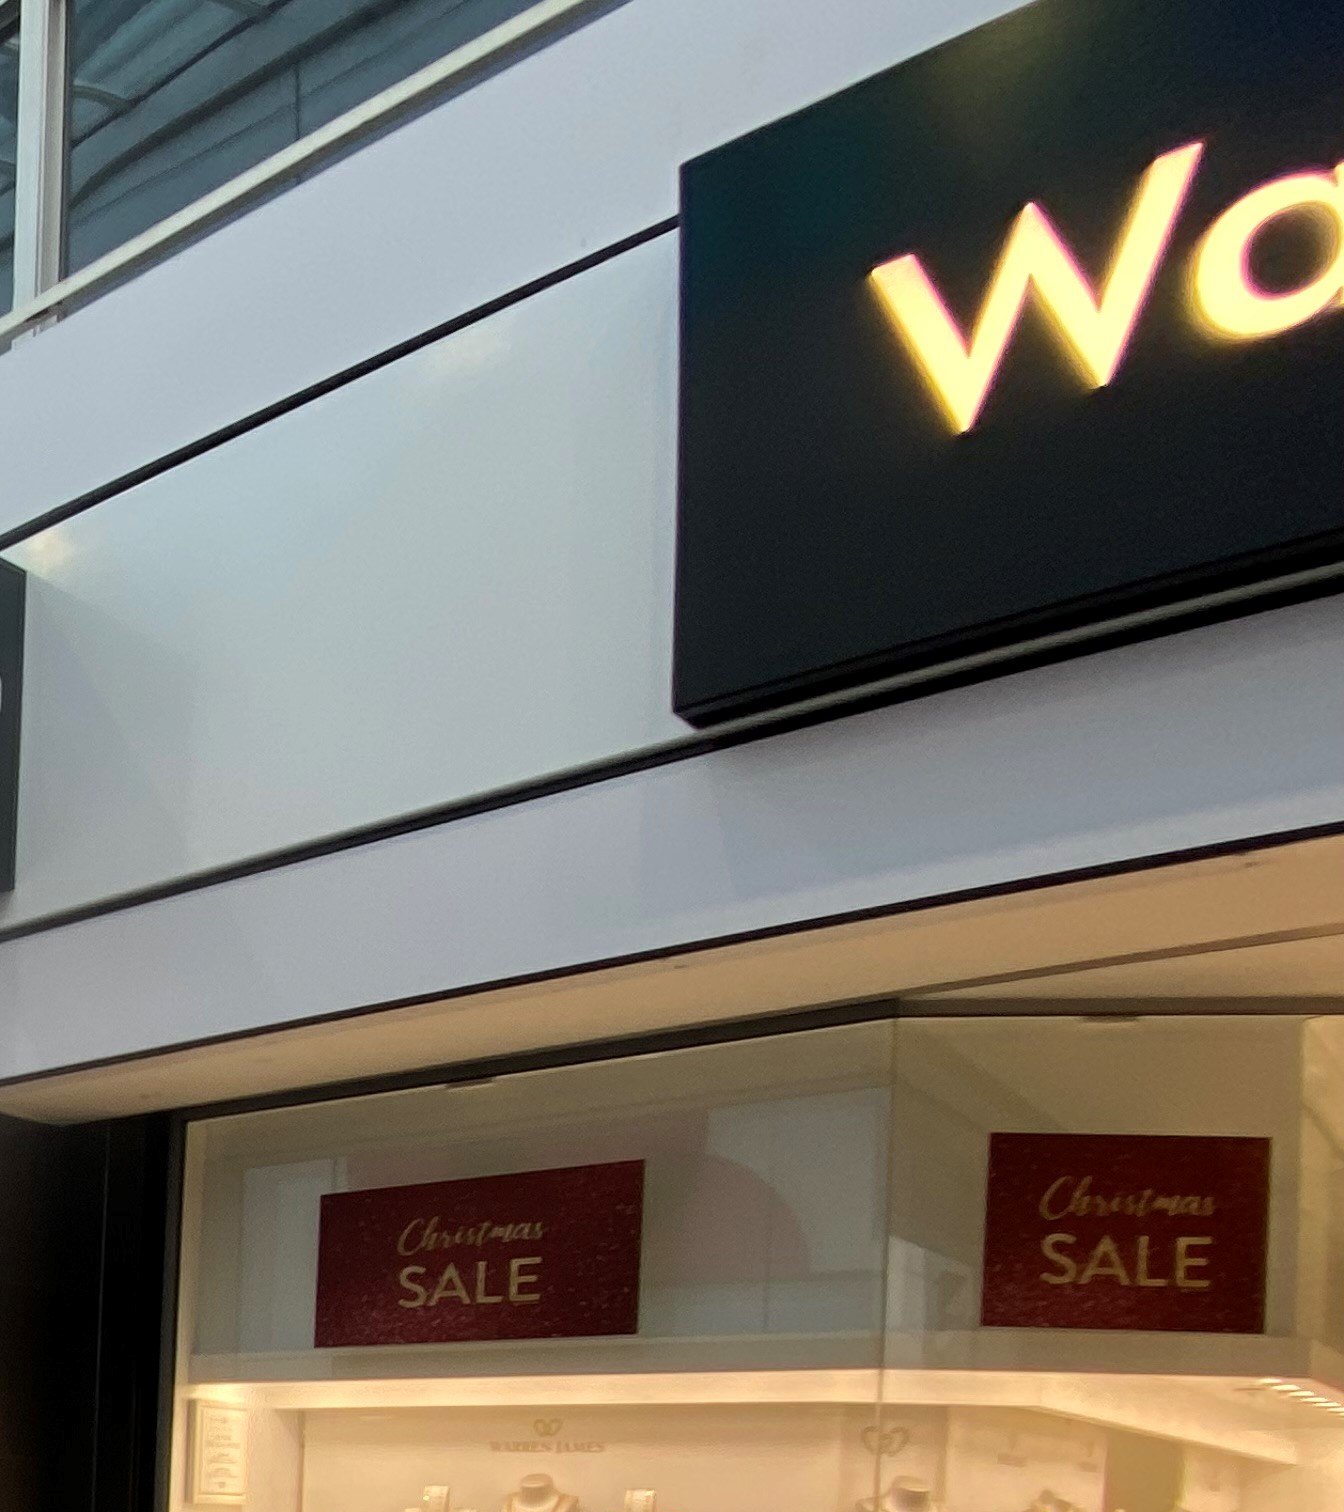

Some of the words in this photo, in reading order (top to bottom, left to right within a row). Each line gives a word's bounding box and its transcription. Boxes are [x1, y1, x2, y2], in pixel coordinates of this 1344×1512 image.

[1039, 1175, 1214, 1221] Christmas
[397, 1215, 545, 1257] Christmas
[1039, 1233, 1212, 1287] SALE
[397, 1256, 543, 1308] SALE
